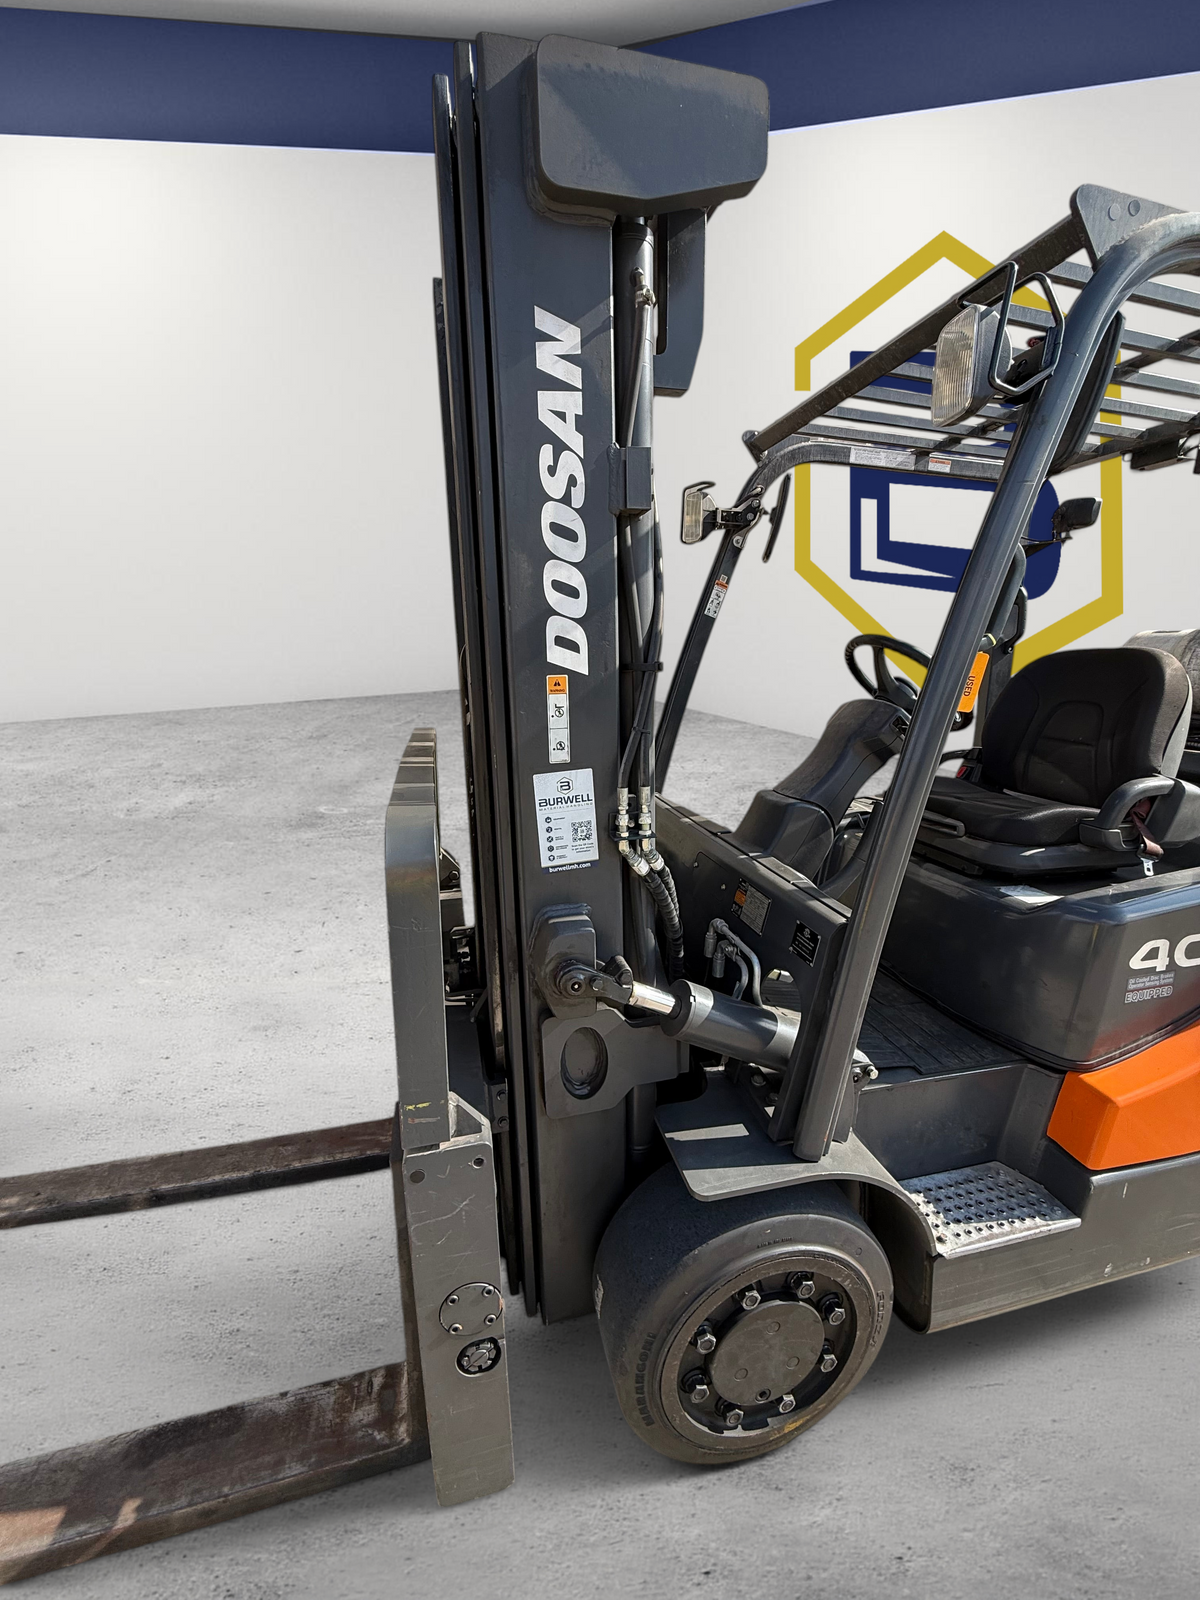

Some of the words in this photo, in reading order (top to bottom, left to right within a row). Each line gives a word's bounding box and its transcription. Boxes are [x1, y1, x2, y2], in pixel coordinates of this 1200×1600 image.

[534, 304, 589, 676] DOOSAN
[963, 675, 976, 697] USED
[538, 793, 593, 808] BURWELL
[548, 862, 592, 873] burwellmh.com
[1124, 986, 1174, 1004] EQUIPPED
